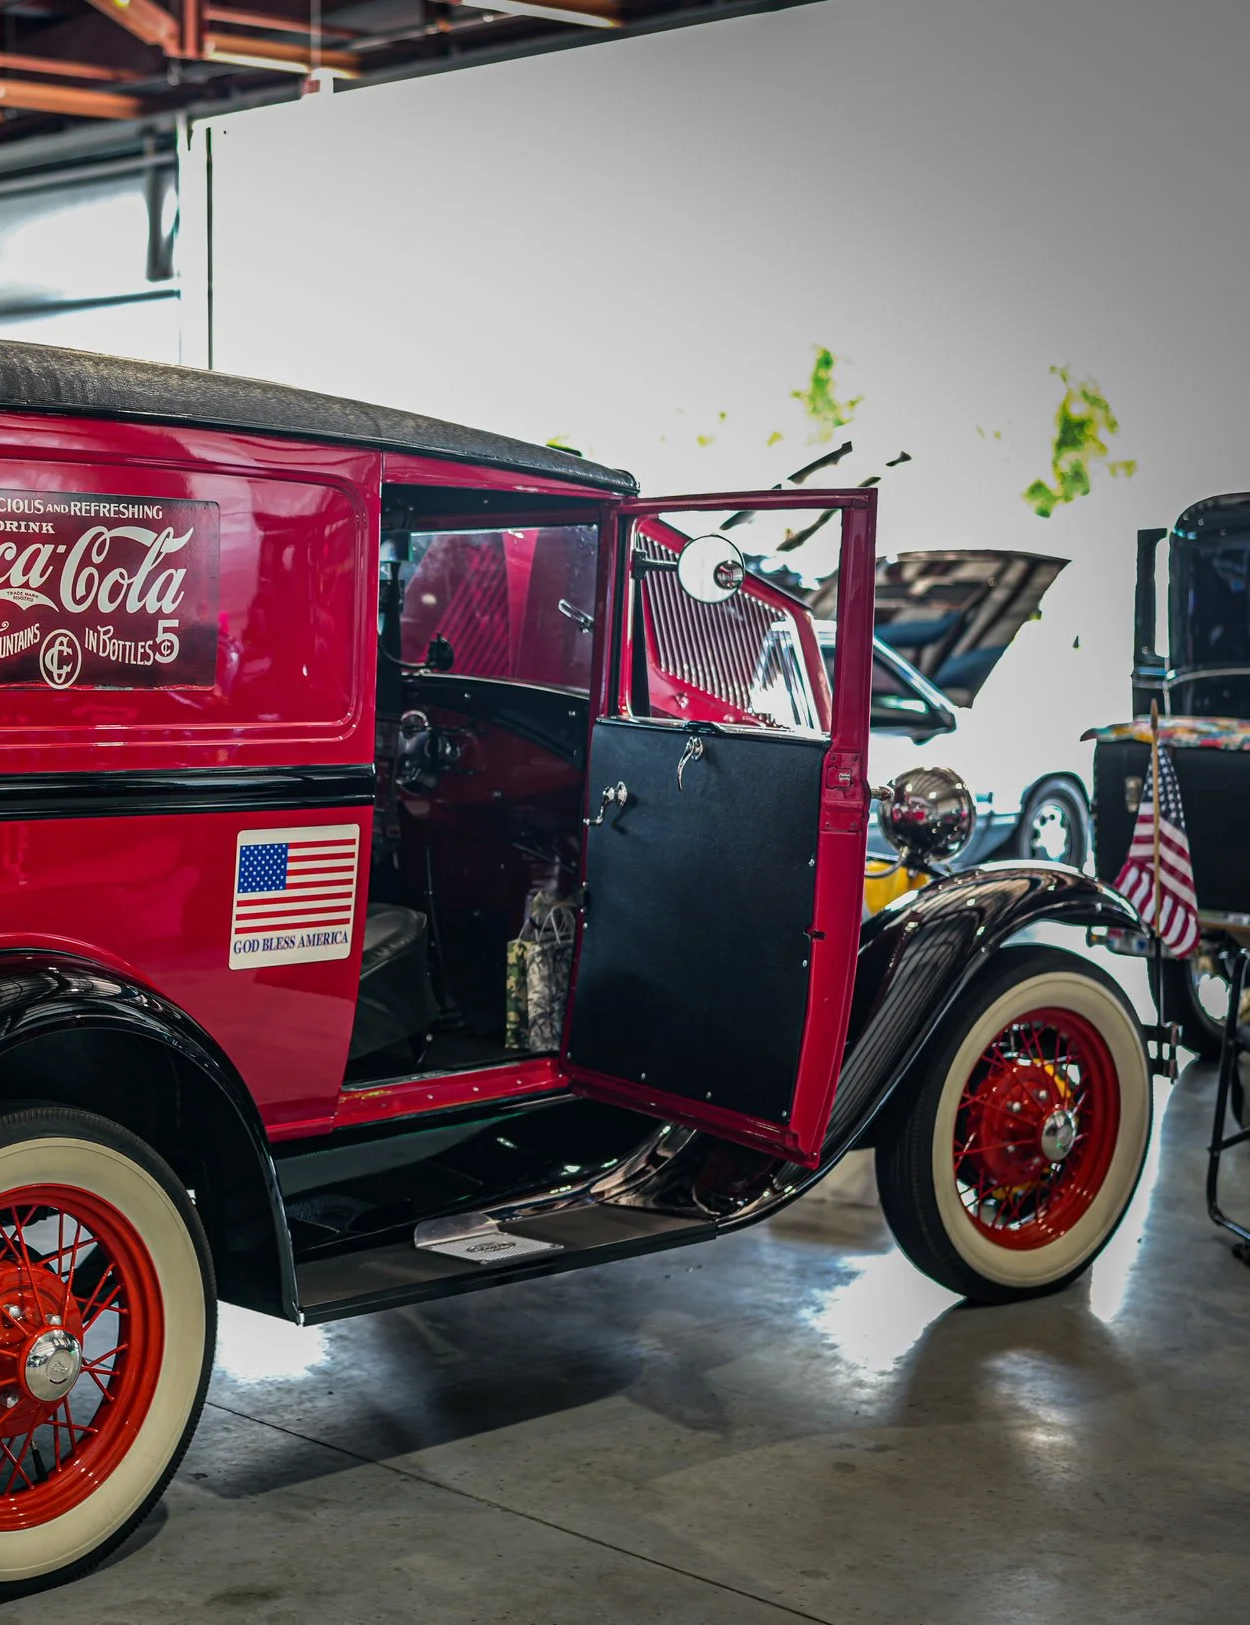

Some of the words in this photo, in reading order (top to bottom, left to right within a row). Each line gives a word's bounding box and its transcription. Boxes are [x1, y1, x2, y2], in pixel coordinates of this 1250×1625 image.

[45, 503, 69, 514] AND
[70, 501, 163, 520] REFRESHING
[84, 626, 98, 650] IN
[97, 625, 154, 666] BOTTLES
[233, 939, 260, 955] GOD
[262, 935, 296, 952] BLESS
[298, 930, 348, 948] AMERICA
